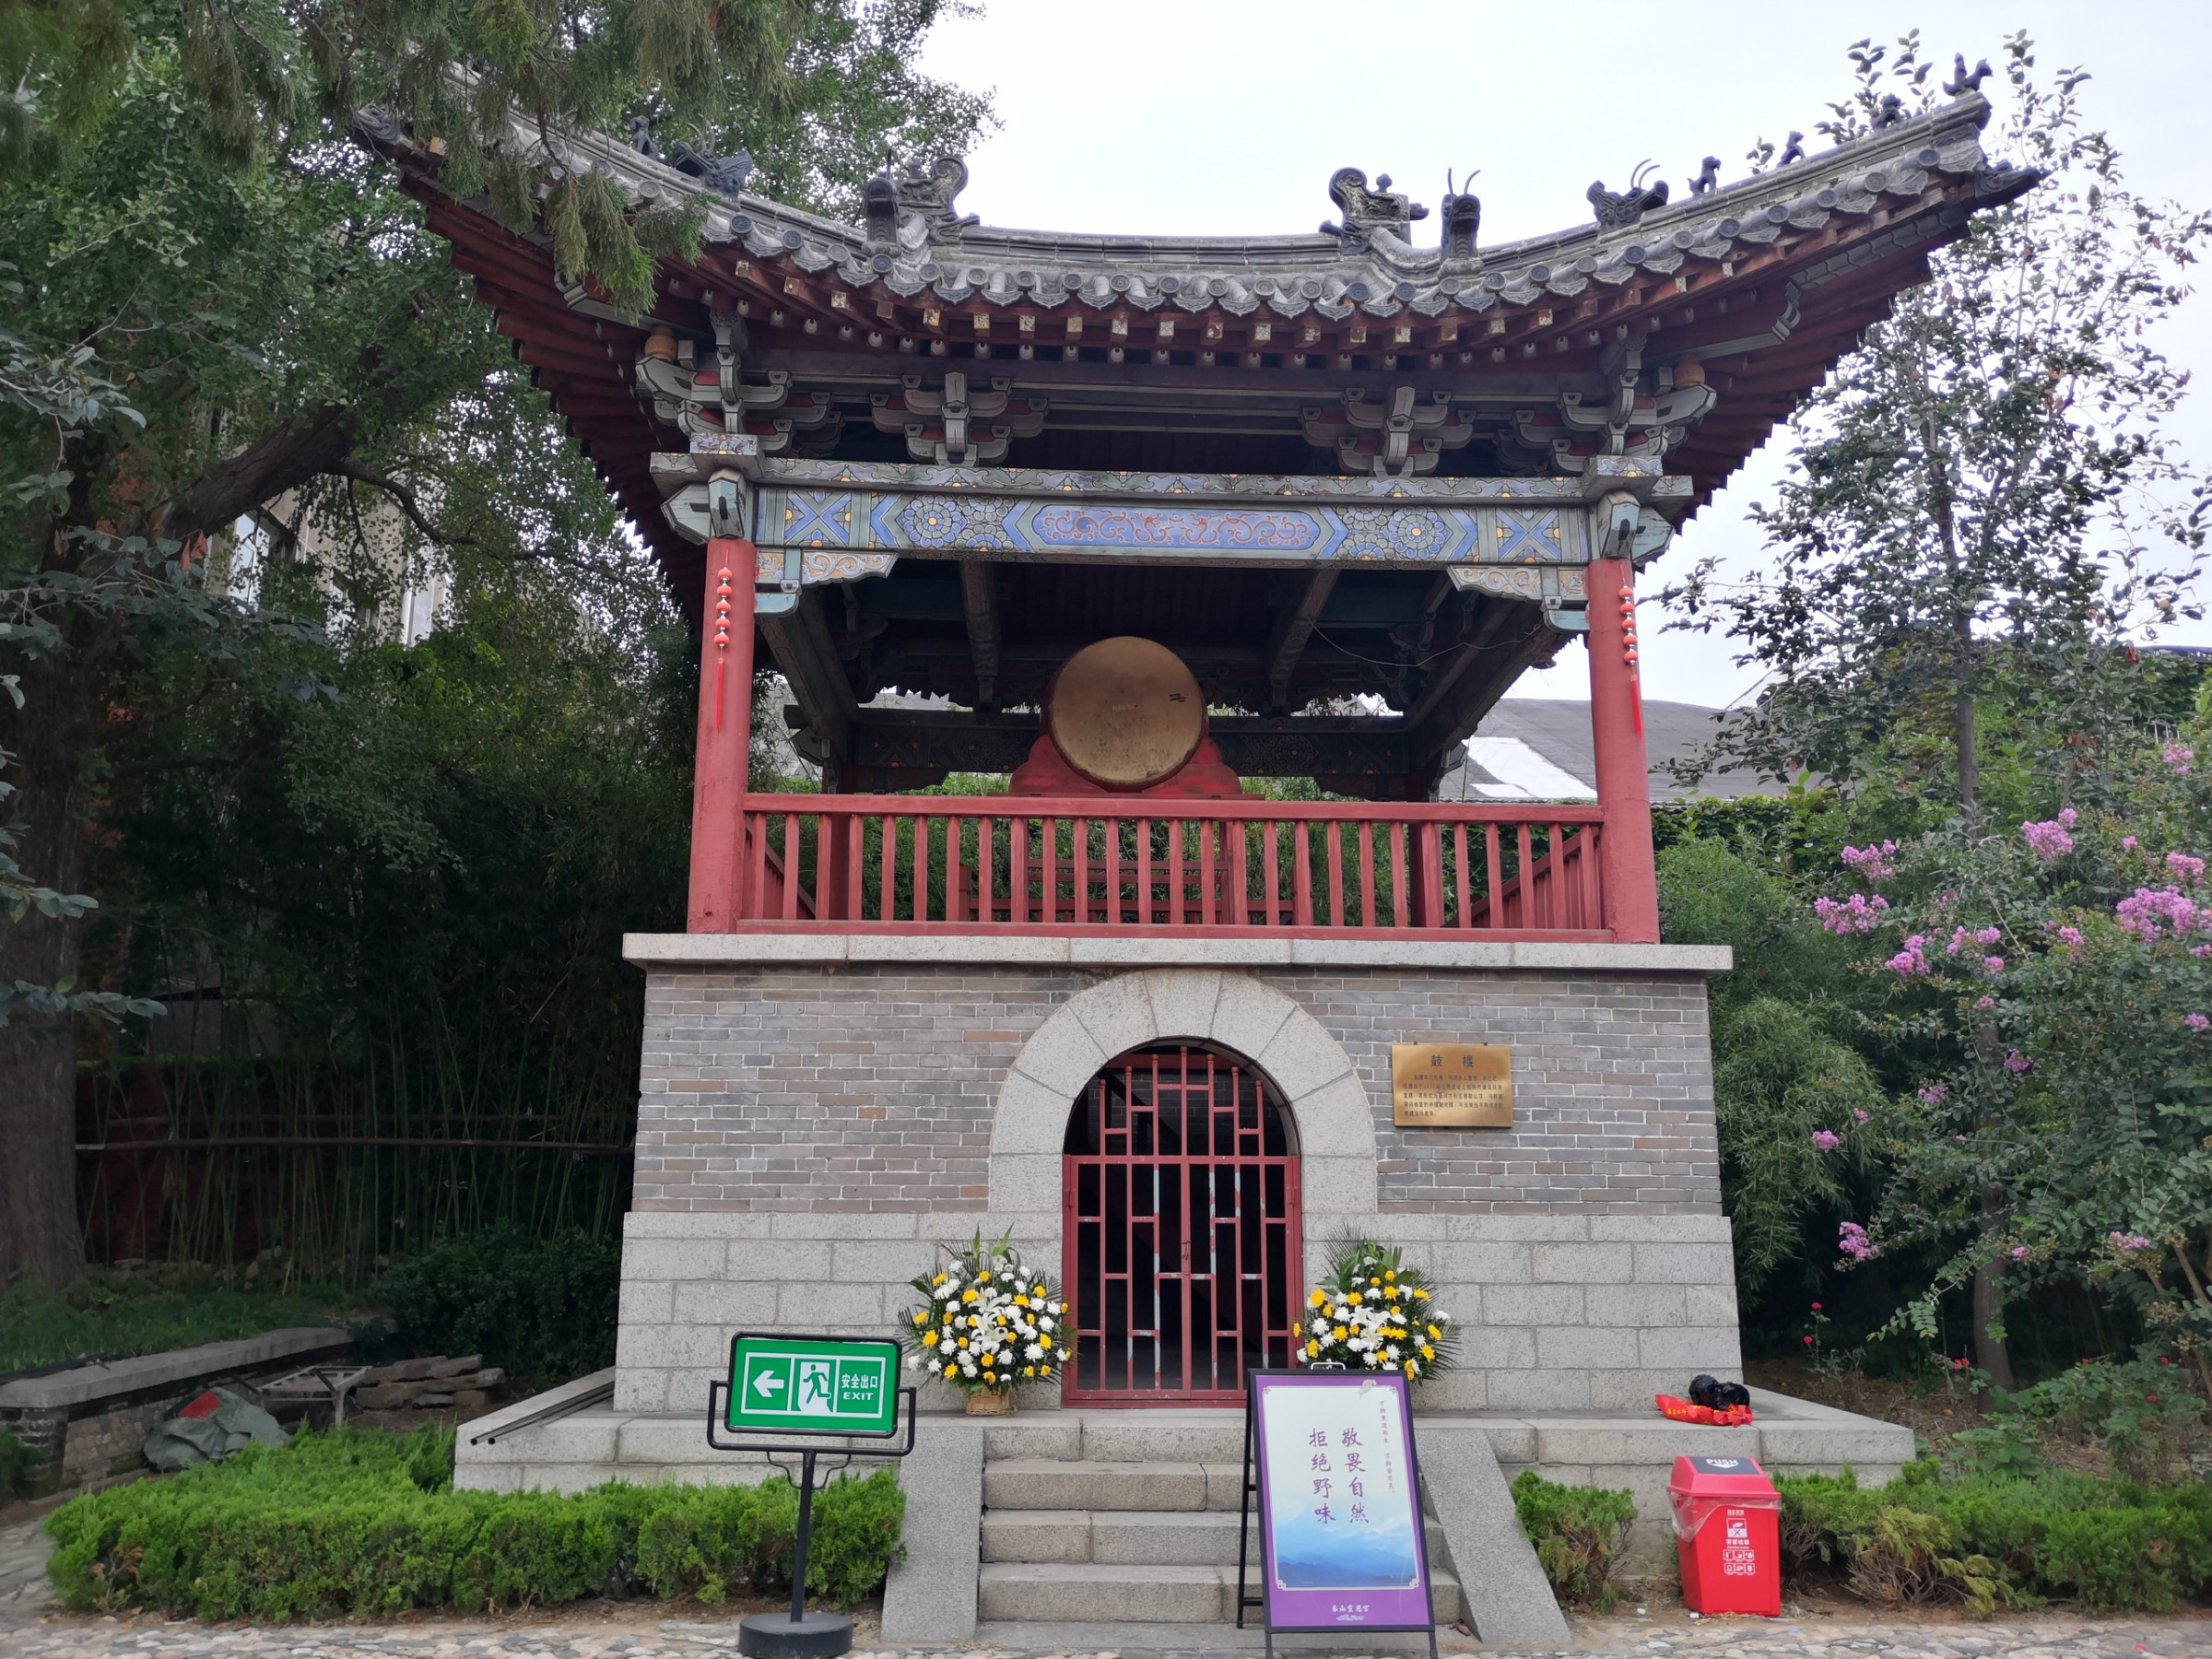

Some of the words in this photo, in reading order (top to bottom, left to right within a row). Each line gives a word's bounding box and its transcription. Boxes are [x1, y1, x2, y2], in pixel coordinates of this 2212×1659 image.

[1430, 1054, 1474, 1067] 鼓楼
[841, 1373, 877, 1389] 安全出口
[842, 1392, 874, 1400] EXIT
[1309, 1427, 1336, 1524] 拒绝野味
[1341, 1427, 1370, 1524] 敬畏自然
